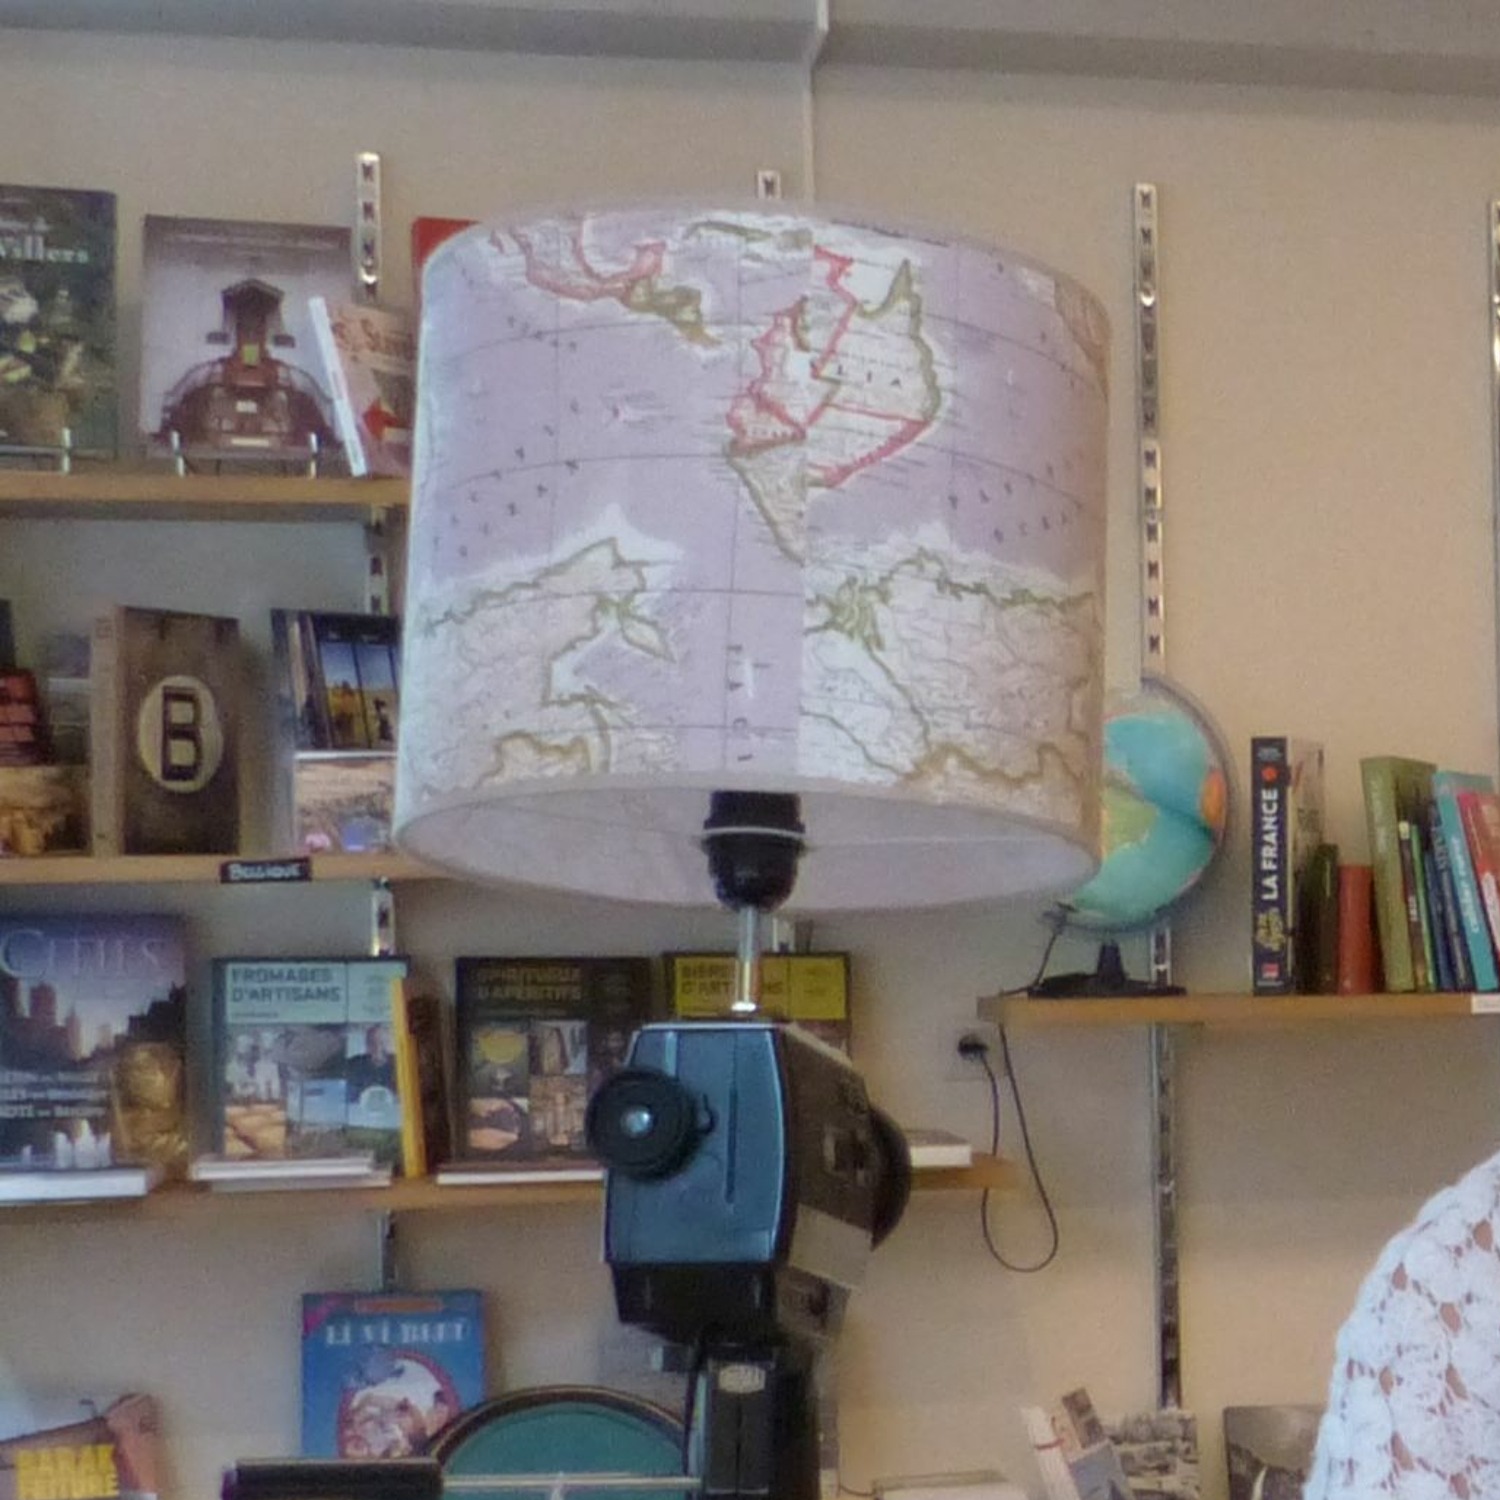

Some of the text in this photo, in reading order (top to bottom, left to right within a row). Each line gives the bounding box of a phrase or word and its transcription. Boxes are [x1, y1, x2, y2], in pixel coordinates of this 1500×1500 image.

[1261, 788, 1279, 901] LA FRANCE
[231, 967, 333, 983] FROMAGES
[231, 986, 341, 1003] D'ARTISANS
